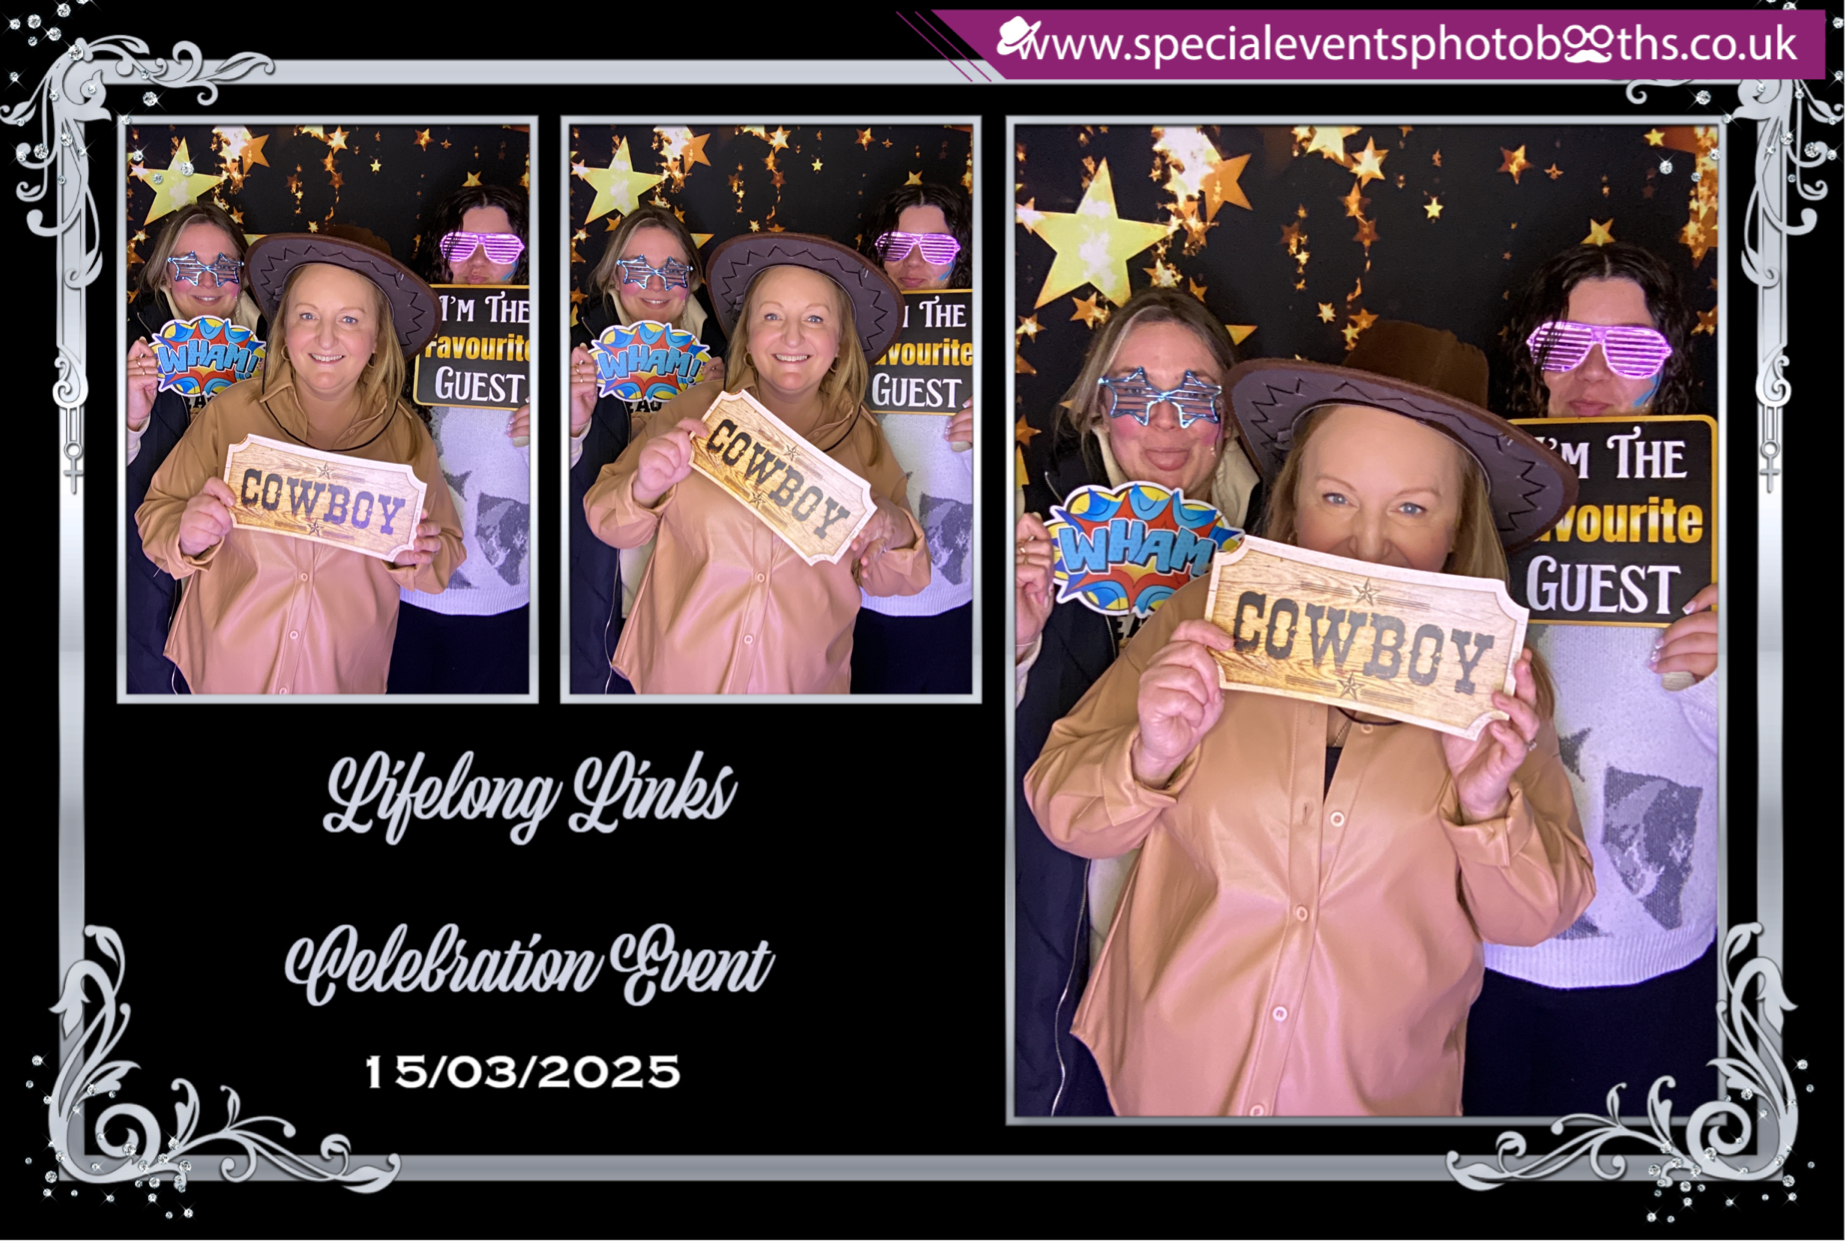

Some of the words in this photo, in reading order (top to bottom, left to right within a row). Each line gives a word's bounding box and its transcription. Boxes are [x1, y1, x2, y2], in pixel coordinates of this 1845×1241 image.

[157, 339, 260, 378] WHAM!
[597, 343, 702, 384] WHAM!
[240, 468, 406, 536] COWBOY
[706, 418, 851, 540] COWBOY
[1233, 590, 1495, 696] COWBOY
